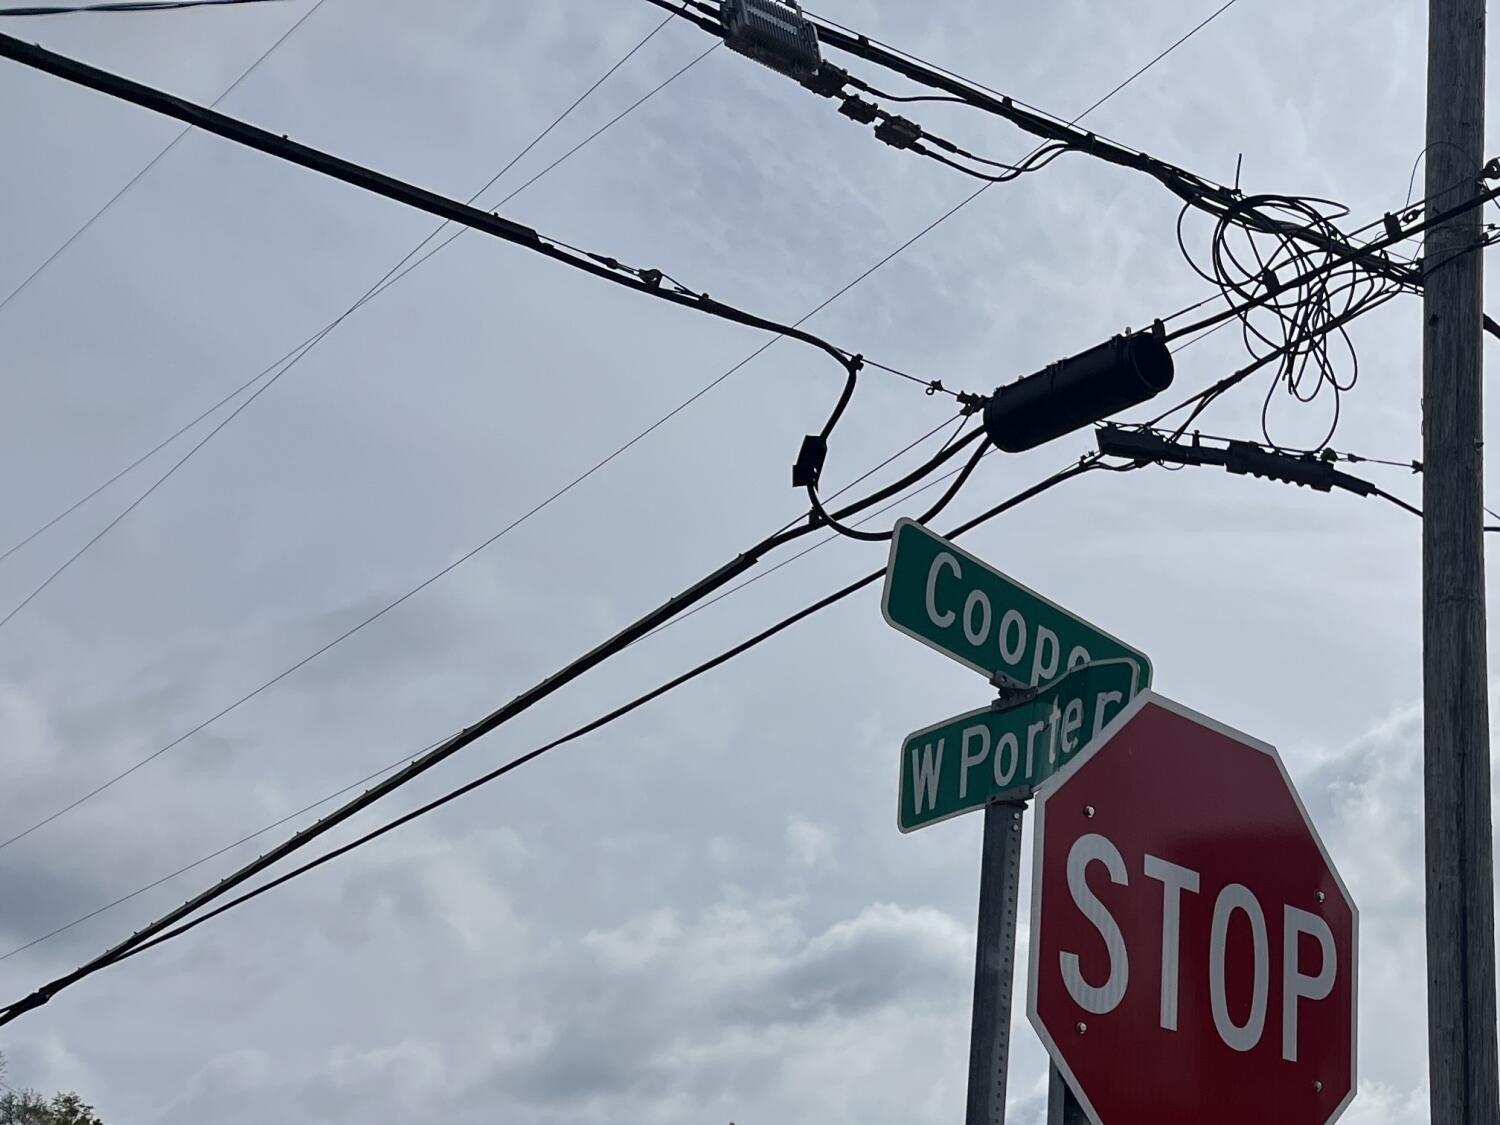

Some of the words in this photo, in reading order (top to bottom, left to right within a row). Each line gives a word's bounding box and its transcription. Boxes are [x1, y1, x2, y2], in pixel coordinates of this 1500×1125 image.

[911, 738, 945, 815] W
[959, 690, 1123, 799] Porter
[1058, 833, 1338, 1063] STOP
